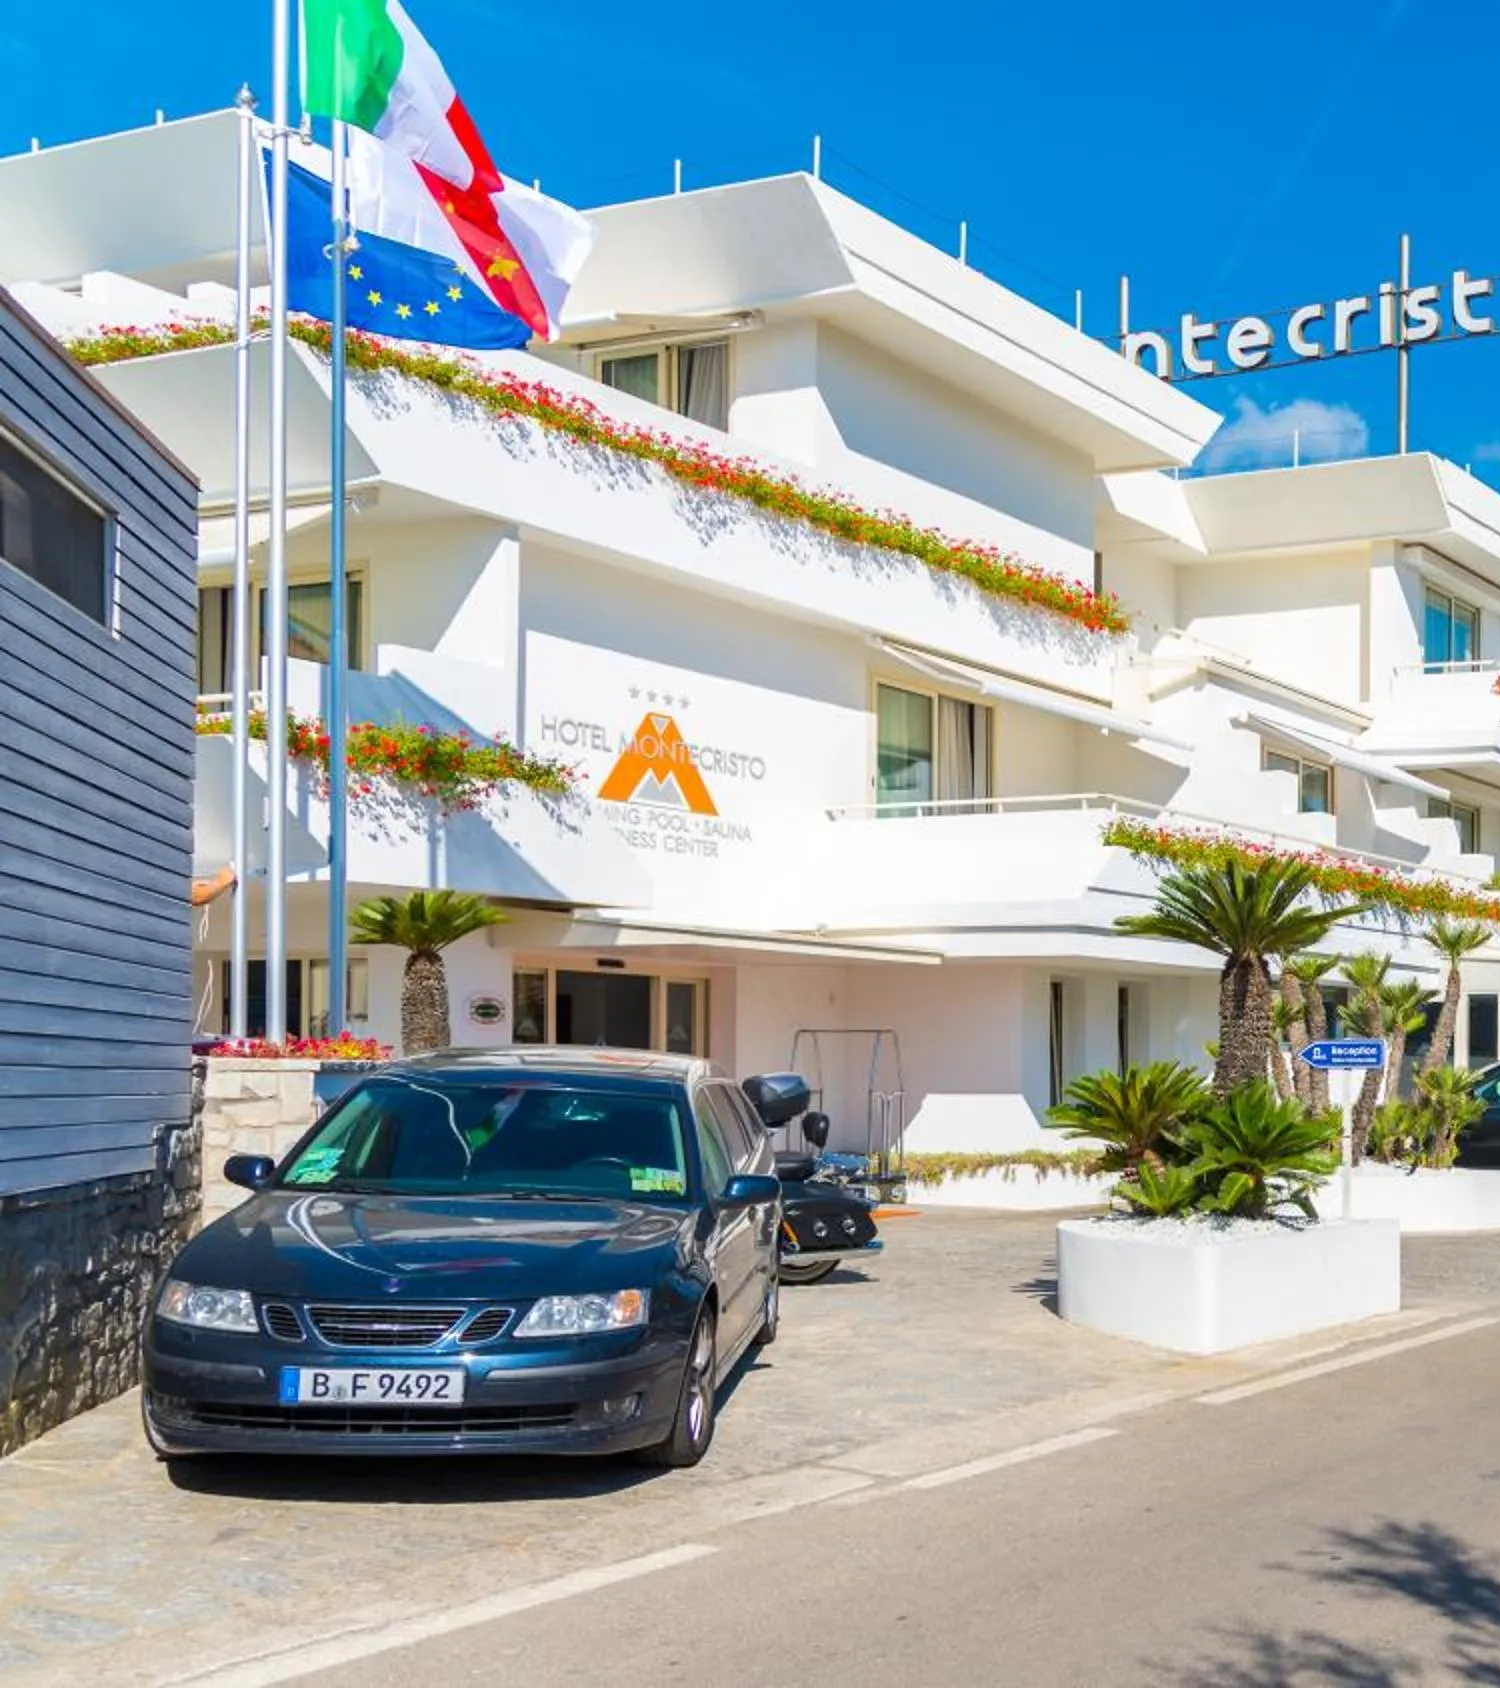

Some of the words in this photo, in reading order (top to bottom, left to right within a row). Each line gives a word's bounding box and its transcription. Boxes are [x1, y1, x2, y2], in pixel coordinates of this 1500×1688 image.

[540, 714, 612, 753] HOTEL
[618, 731, 767, 781] MONTECRISTO
[647, 809, 690, 833] POOL
[703, 819, 753, 842] SAUNA
[663, 834, 719, 858] CENTER
[312, 1372, 330, 1398] B
[352, 1373, 371, 1398] F
[378, 1373, 450, 1399] 9492
